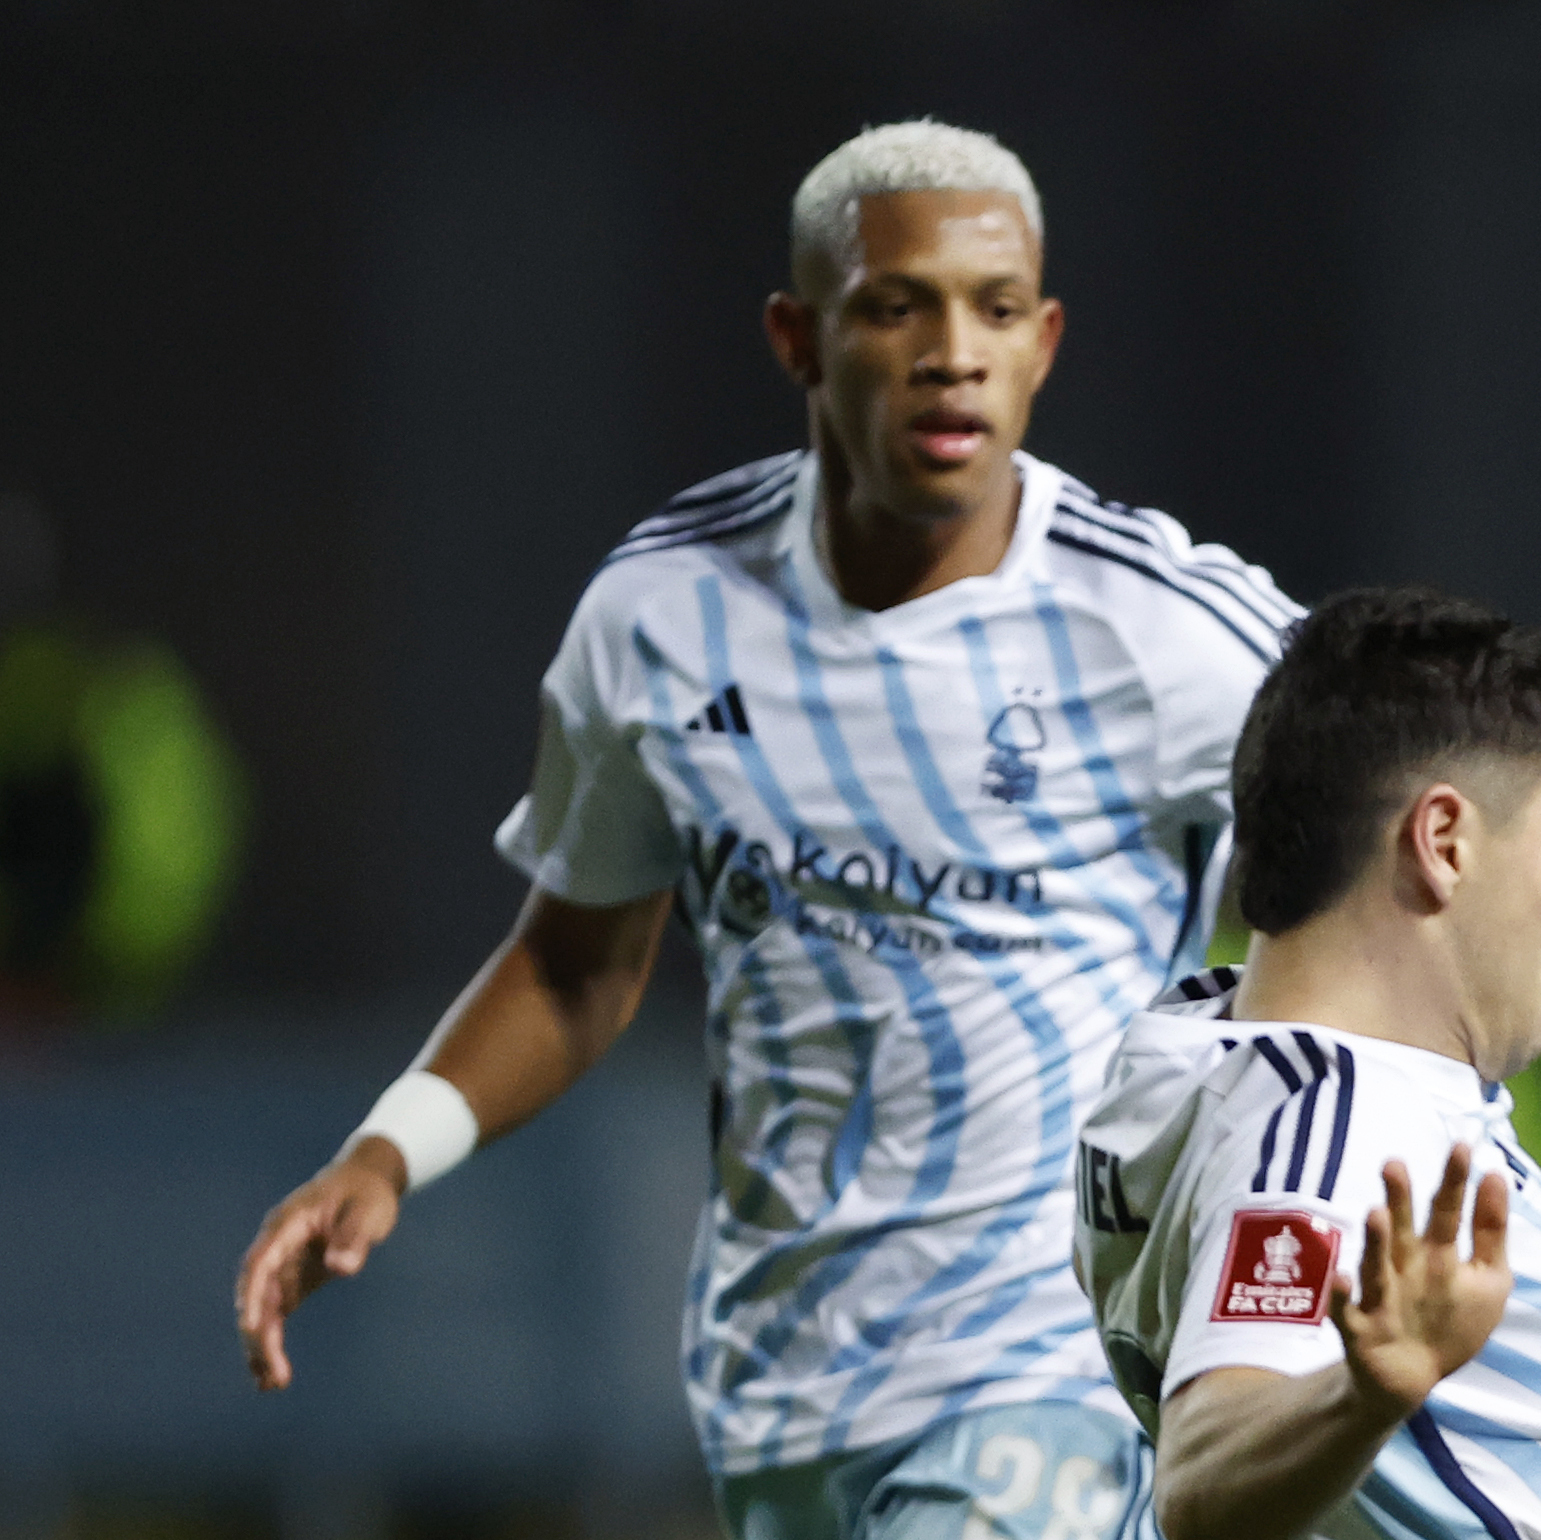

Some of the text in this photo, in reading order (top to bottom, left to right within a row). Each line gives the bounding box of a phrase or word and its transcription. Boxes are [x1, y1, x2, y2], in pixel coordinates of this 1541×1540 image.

[1078, 1140, 1150, 1233] IEL
[1227, 1295, 1313, 1316] FA CUP
